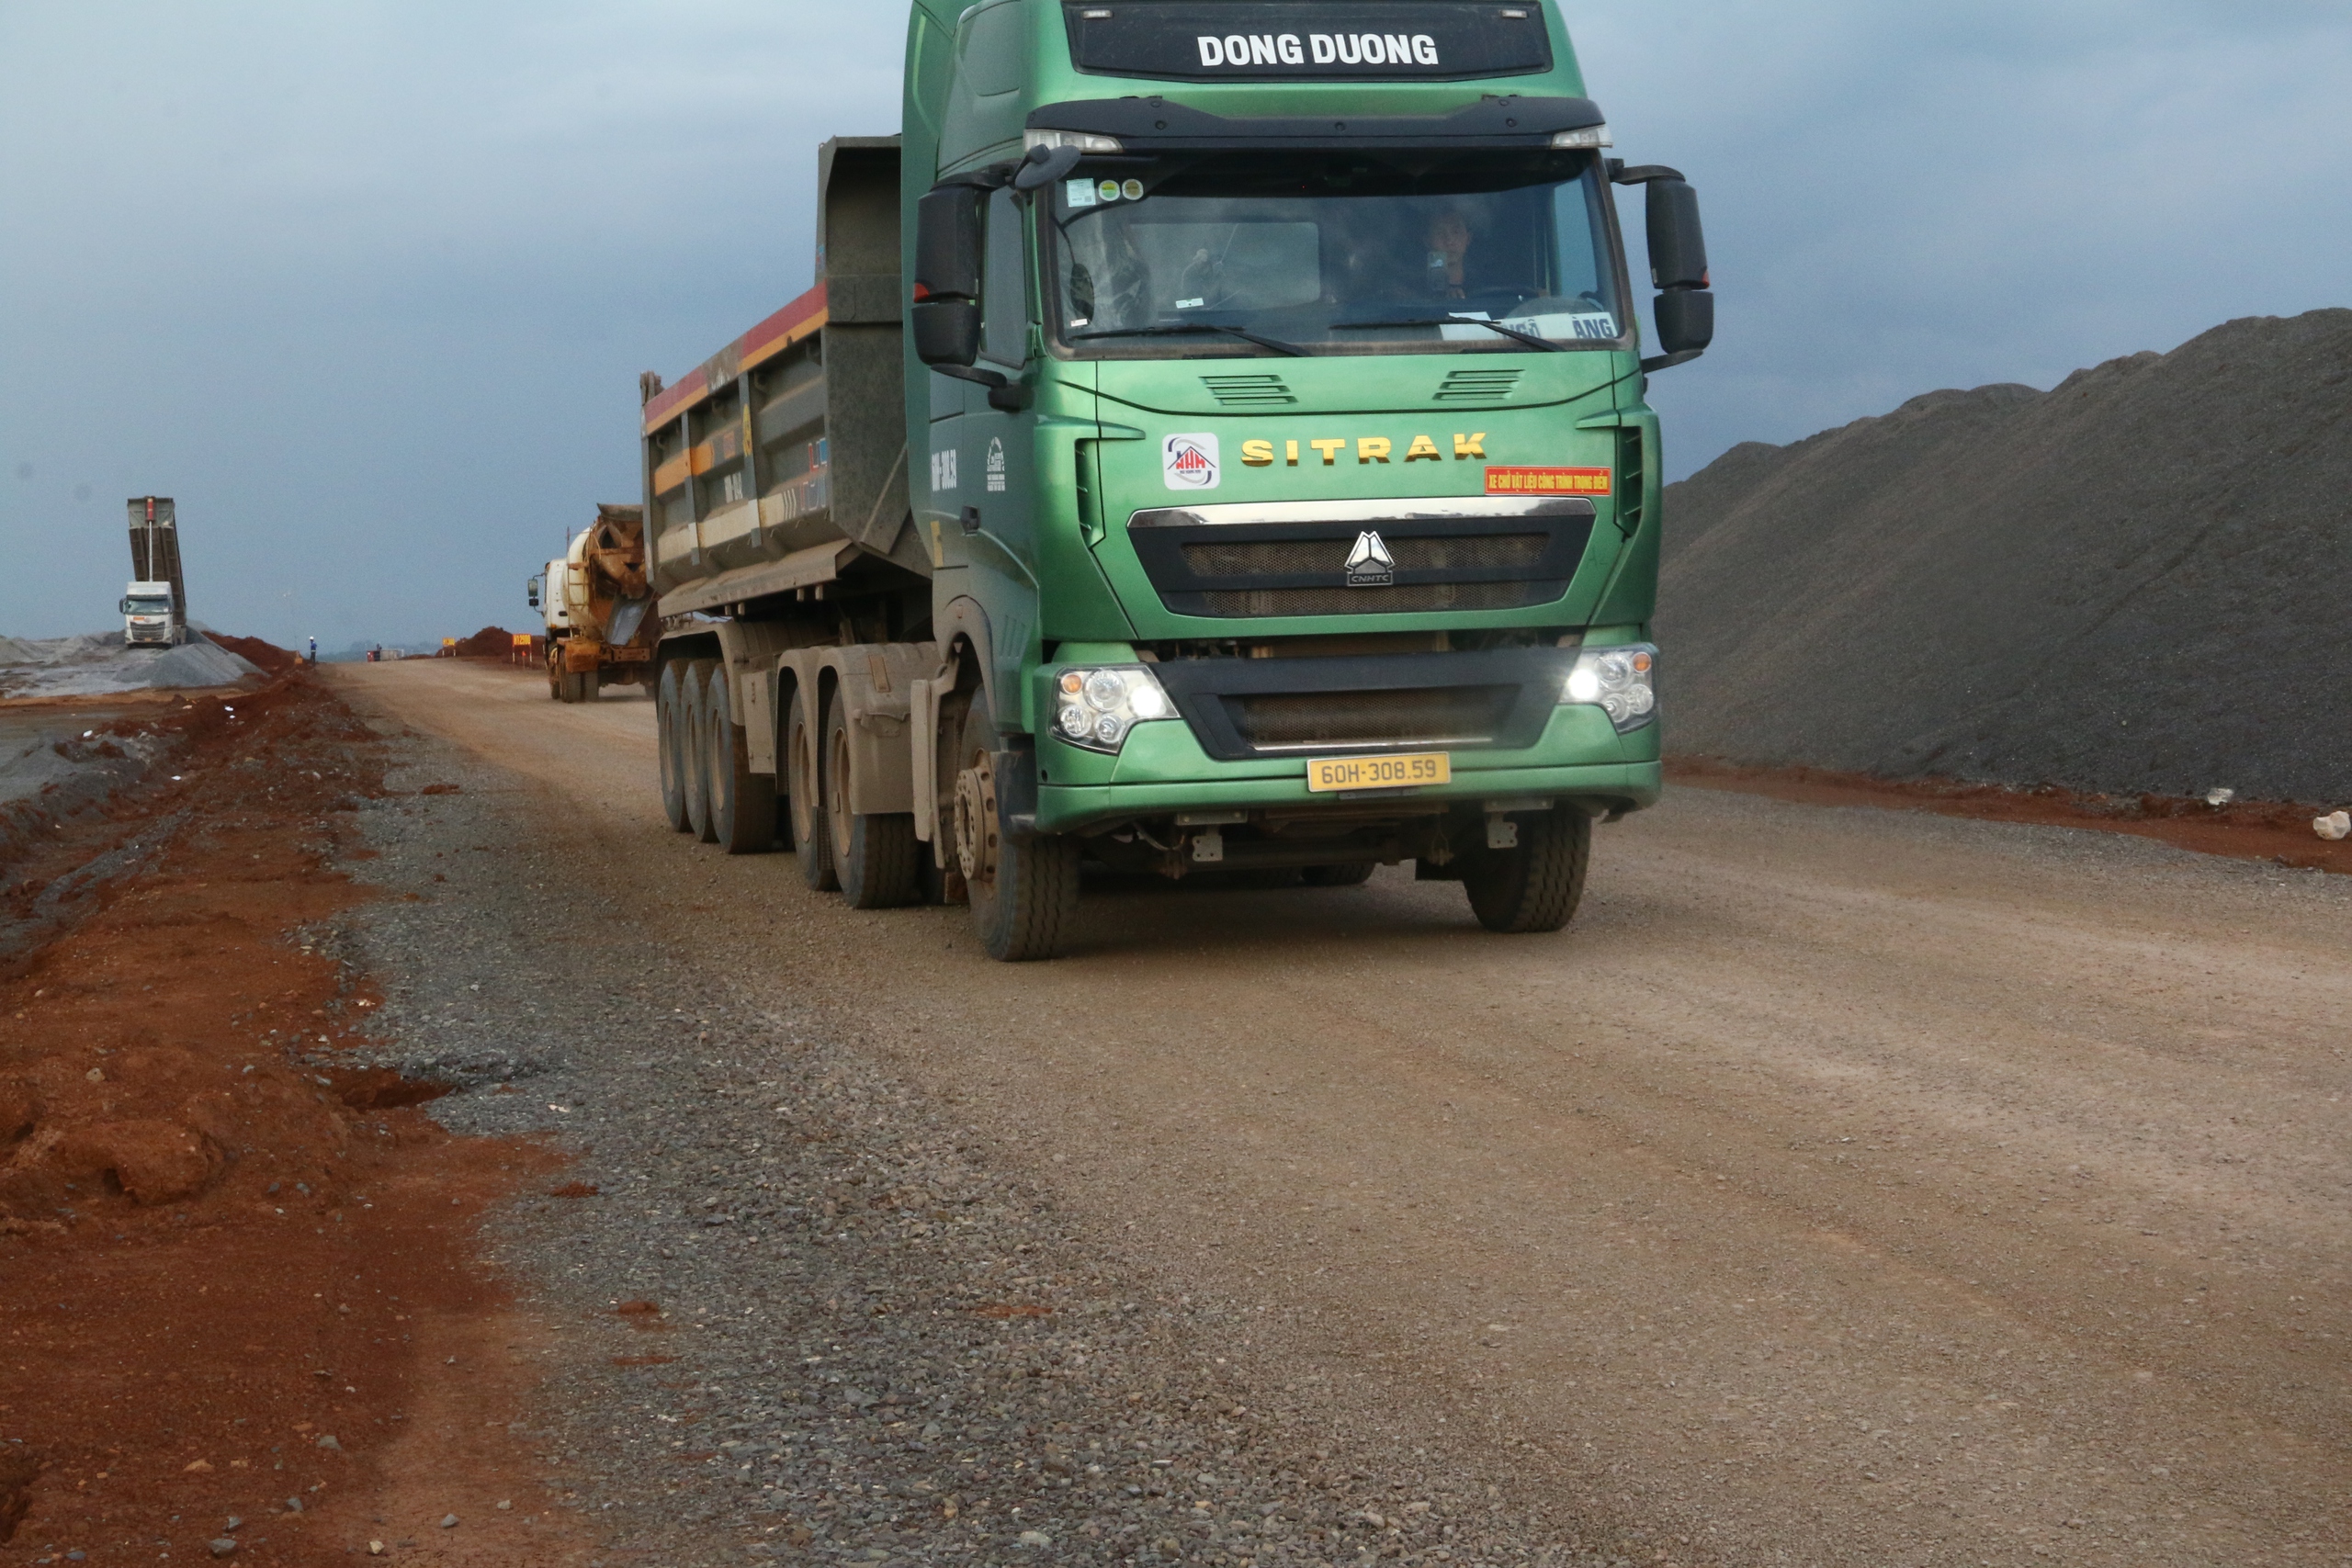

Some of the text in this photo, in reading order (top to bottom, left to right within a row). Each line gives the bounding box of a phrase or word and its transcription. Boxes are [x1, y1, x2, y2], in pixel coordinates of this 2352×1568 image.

[1197, 33, 1439, 67] DONG DUONG
[1241, 433, 1487, 467] SITRAK
[1351, 574, 1388, 582] CNHTC
[1321, 760, 1437, 784] 60H-308.59
